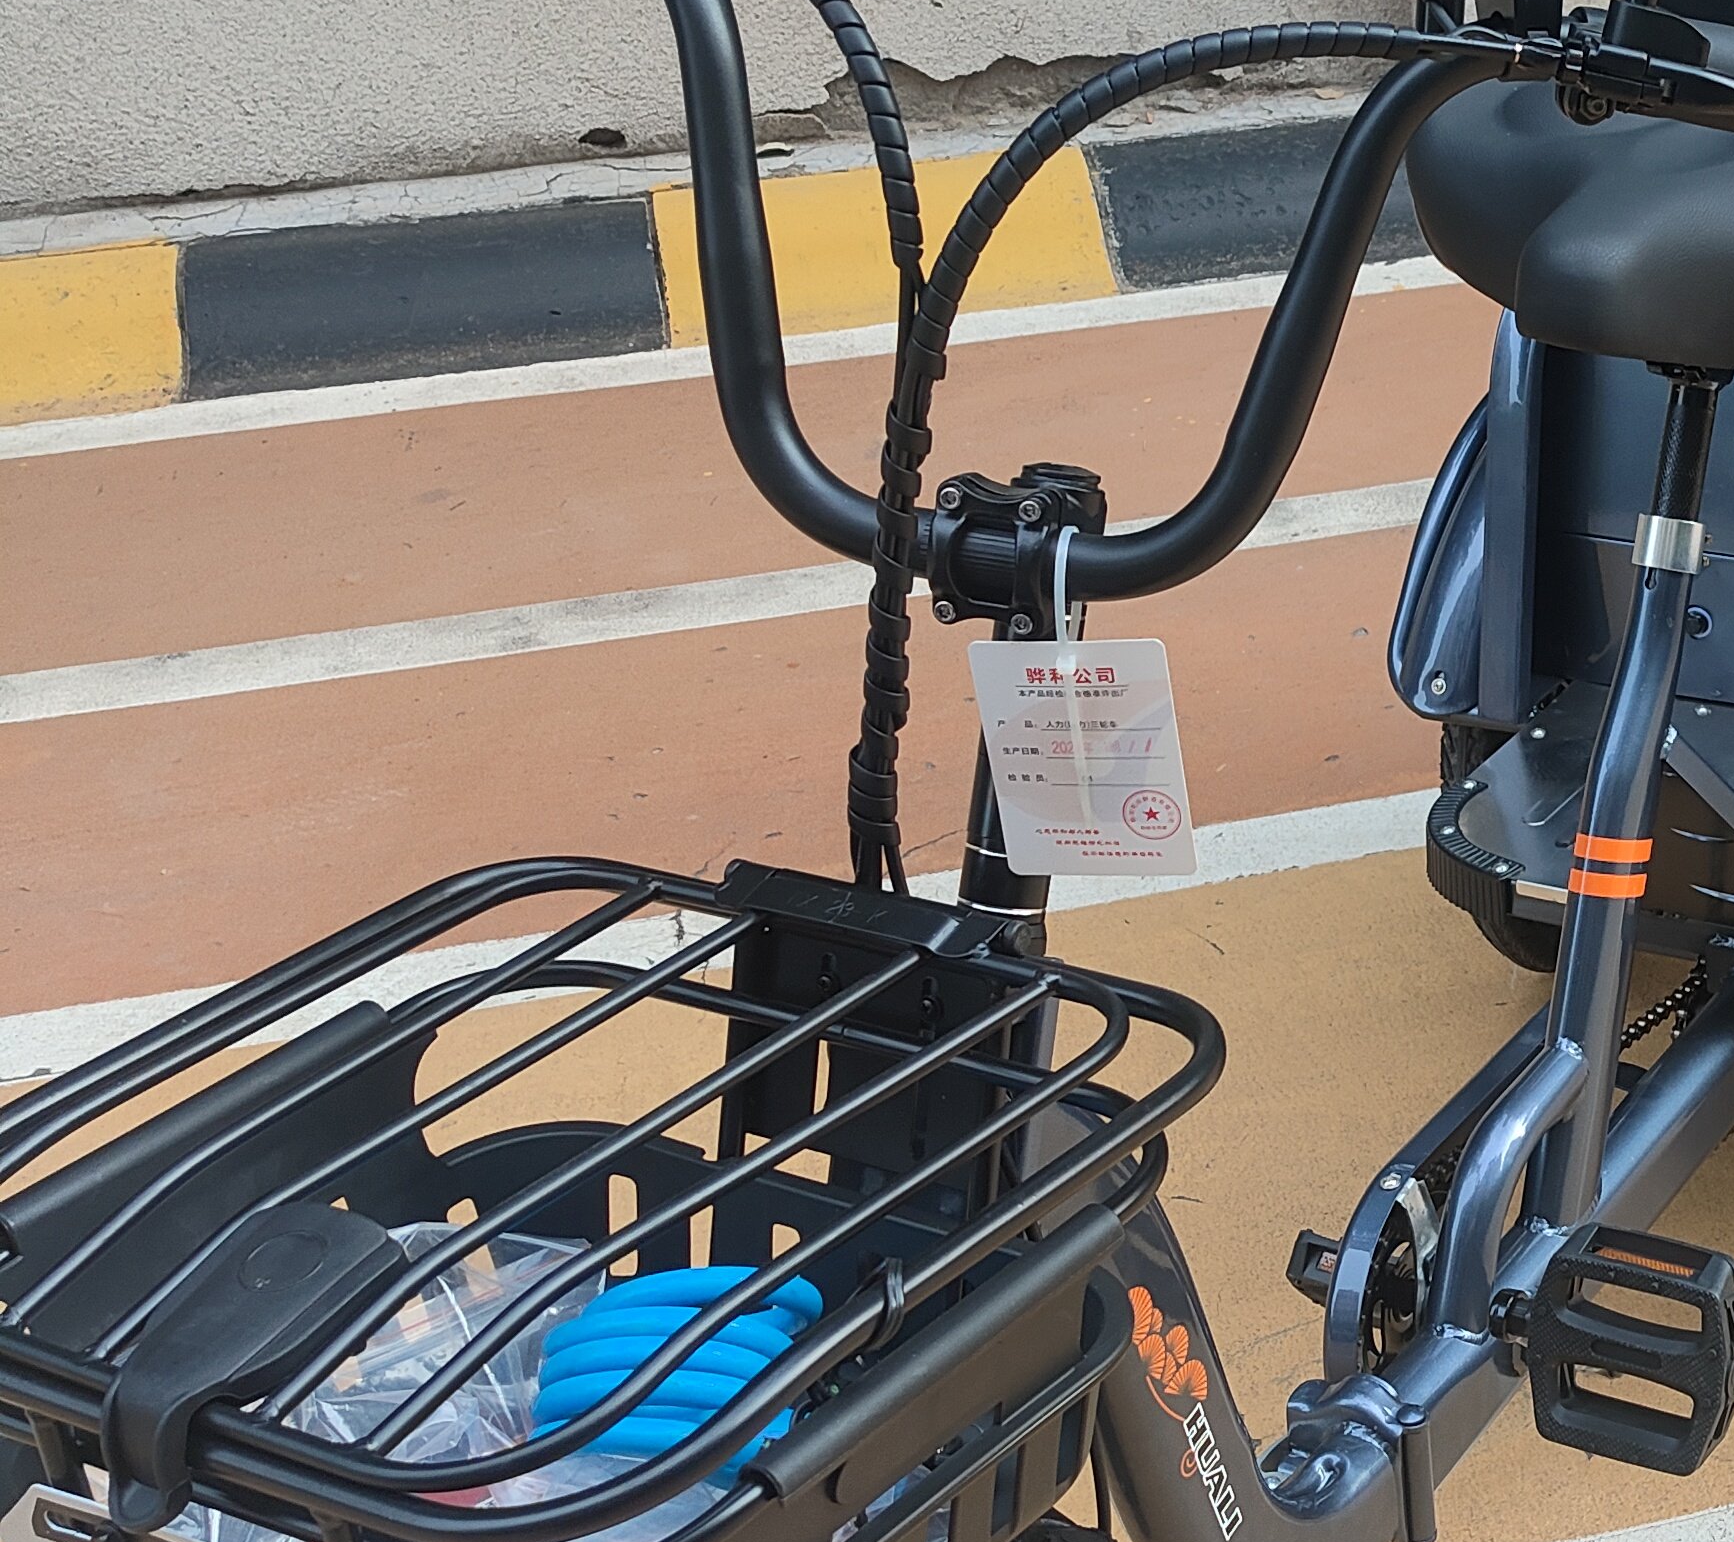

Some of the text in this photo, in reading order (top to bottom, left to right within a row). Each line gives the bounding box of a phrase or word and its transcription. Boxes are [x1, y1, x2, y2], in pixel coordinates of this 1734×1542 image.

[1018, 688, 1129, 699] 本产品经检合格准许出厂
[1182, 1401, 1243, 1542] HUALI
